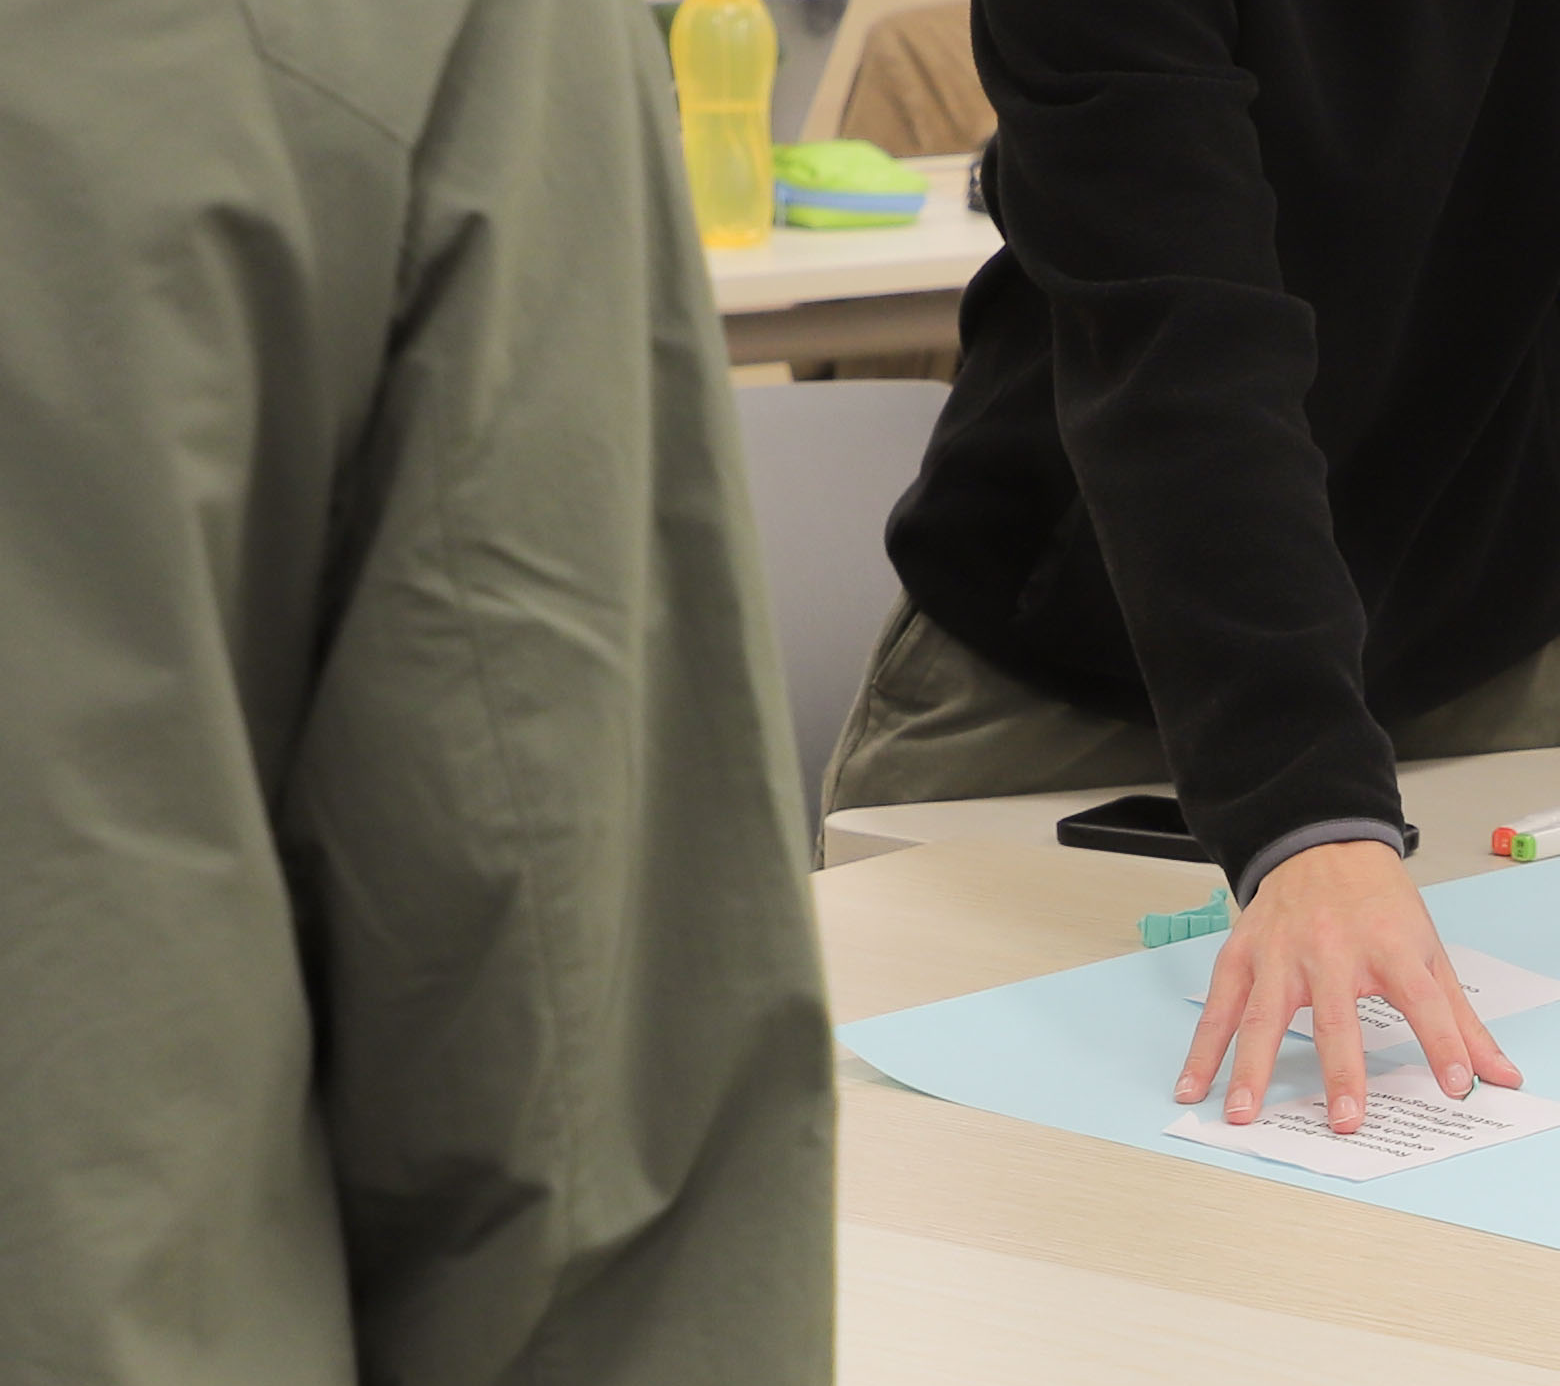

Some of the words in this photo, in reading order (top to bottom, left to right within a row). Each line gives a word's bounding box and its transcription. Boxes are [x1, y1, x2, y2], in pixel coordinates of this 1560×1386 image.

[1253, 1118, 1278, 1126] AI
[1383, 1105, 1475, 1130] sufficiency
[1277, 1123, 1318, 1136] both
[1383, 1127, 1421, 1139] tech
[1318, 1131, 1412, 1158] Reconsider
